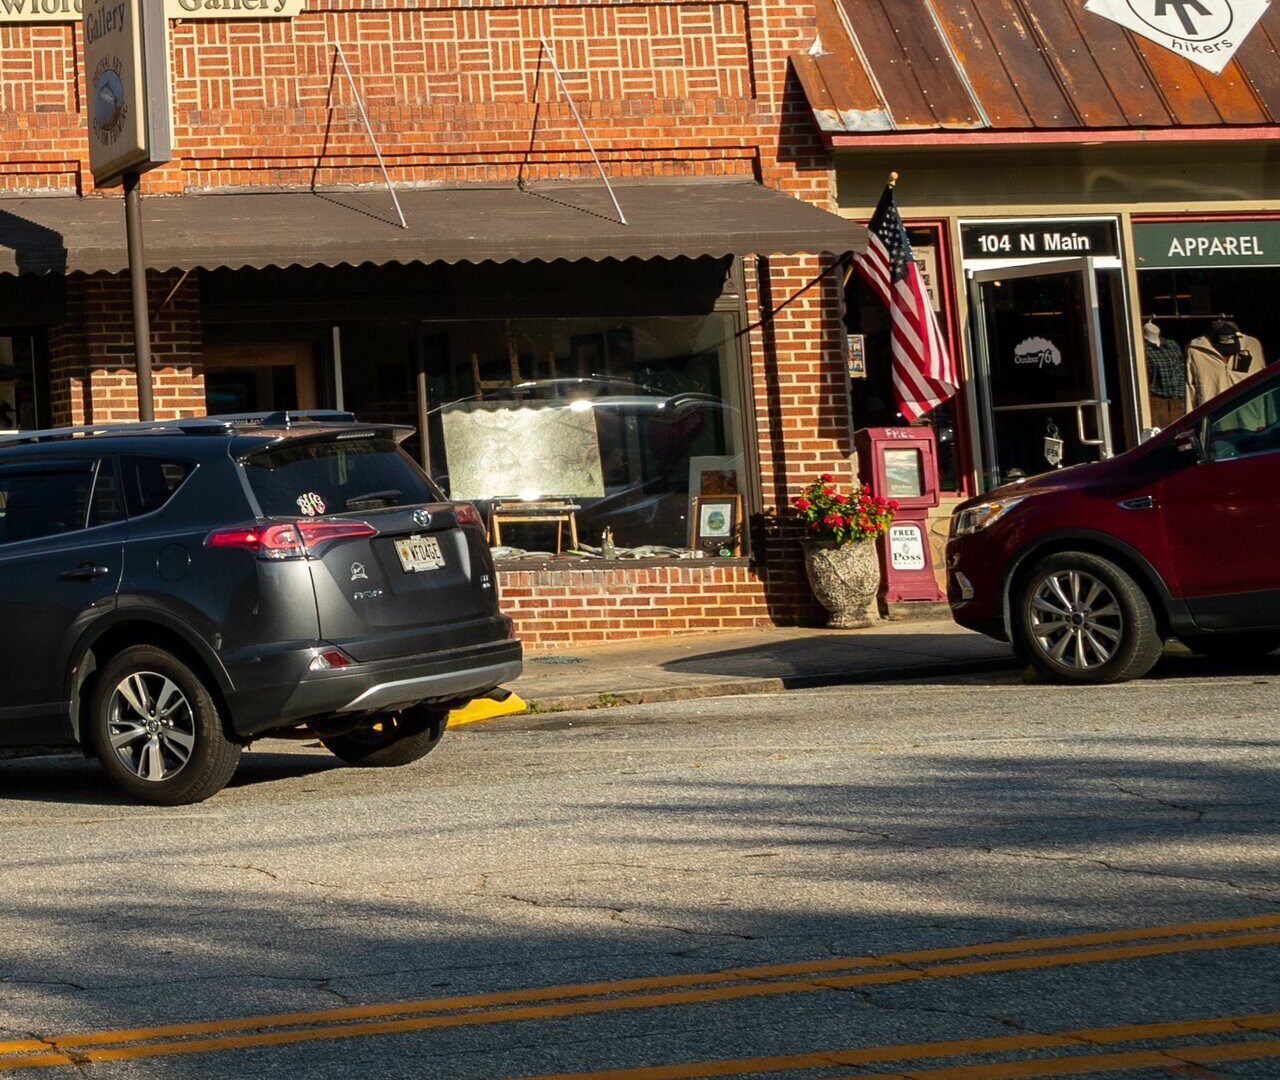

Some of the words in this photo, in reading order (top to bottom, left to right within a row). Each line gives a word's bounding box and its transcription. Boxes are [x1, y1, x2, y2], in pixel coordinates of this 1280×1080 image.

[87, 2, 125, 45] Gallery
[1172, 38, 1233, 54] hikers
[978, 234, 1011, 253] 104
[1020, 233, 1036, 251] N
[1043, 231, 1090, 251] Main
[1167, 236, 1264, 257] APPAREL
[1038, 350, 1051, 368] 76
